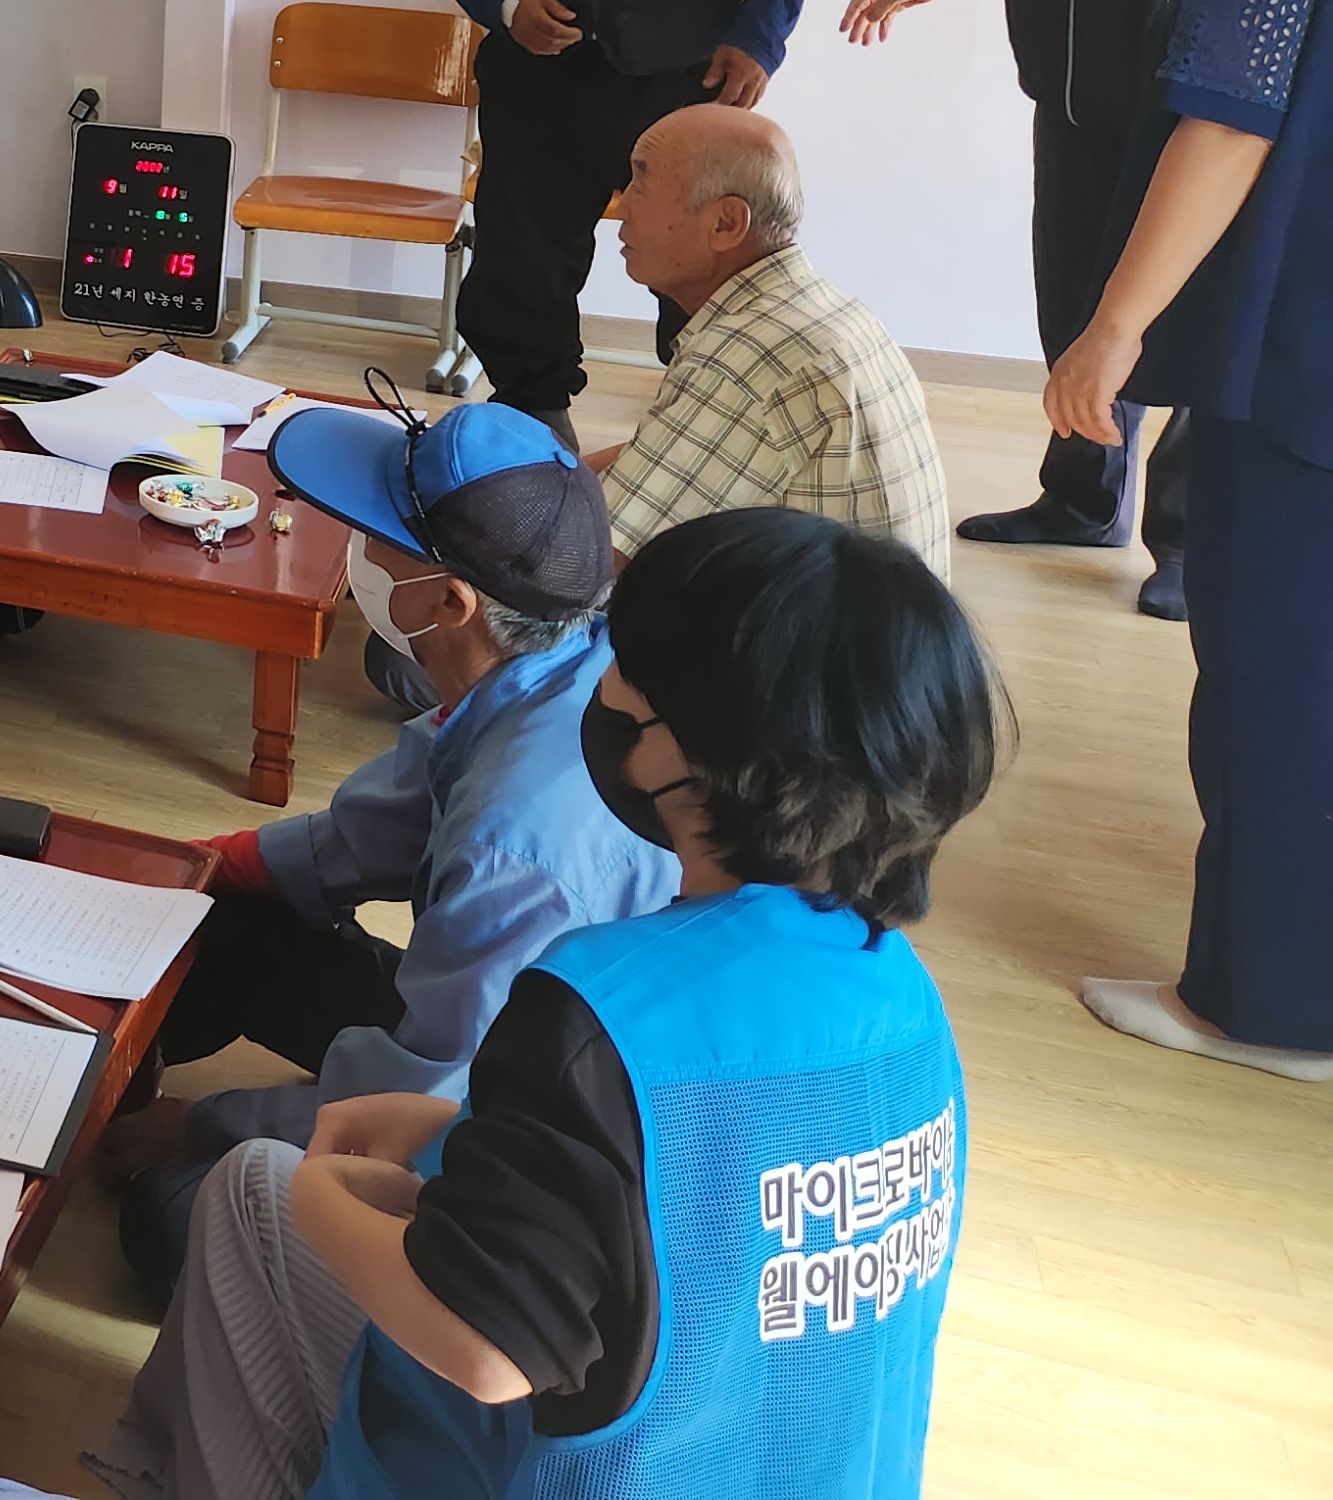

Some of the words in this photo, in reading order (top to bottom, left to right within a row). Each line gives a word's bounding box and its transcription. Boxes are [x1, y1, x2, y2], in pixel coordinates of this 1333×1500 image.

[131, 140, 174, 153] KAPPA
[169, 253, 196, 278] 15
[74, 283, 104, 299] 21년
[110, 287, 136, 303] 세지
[143, 290, 184, 309] 한농연
[190, 297, 205, 312] 증
